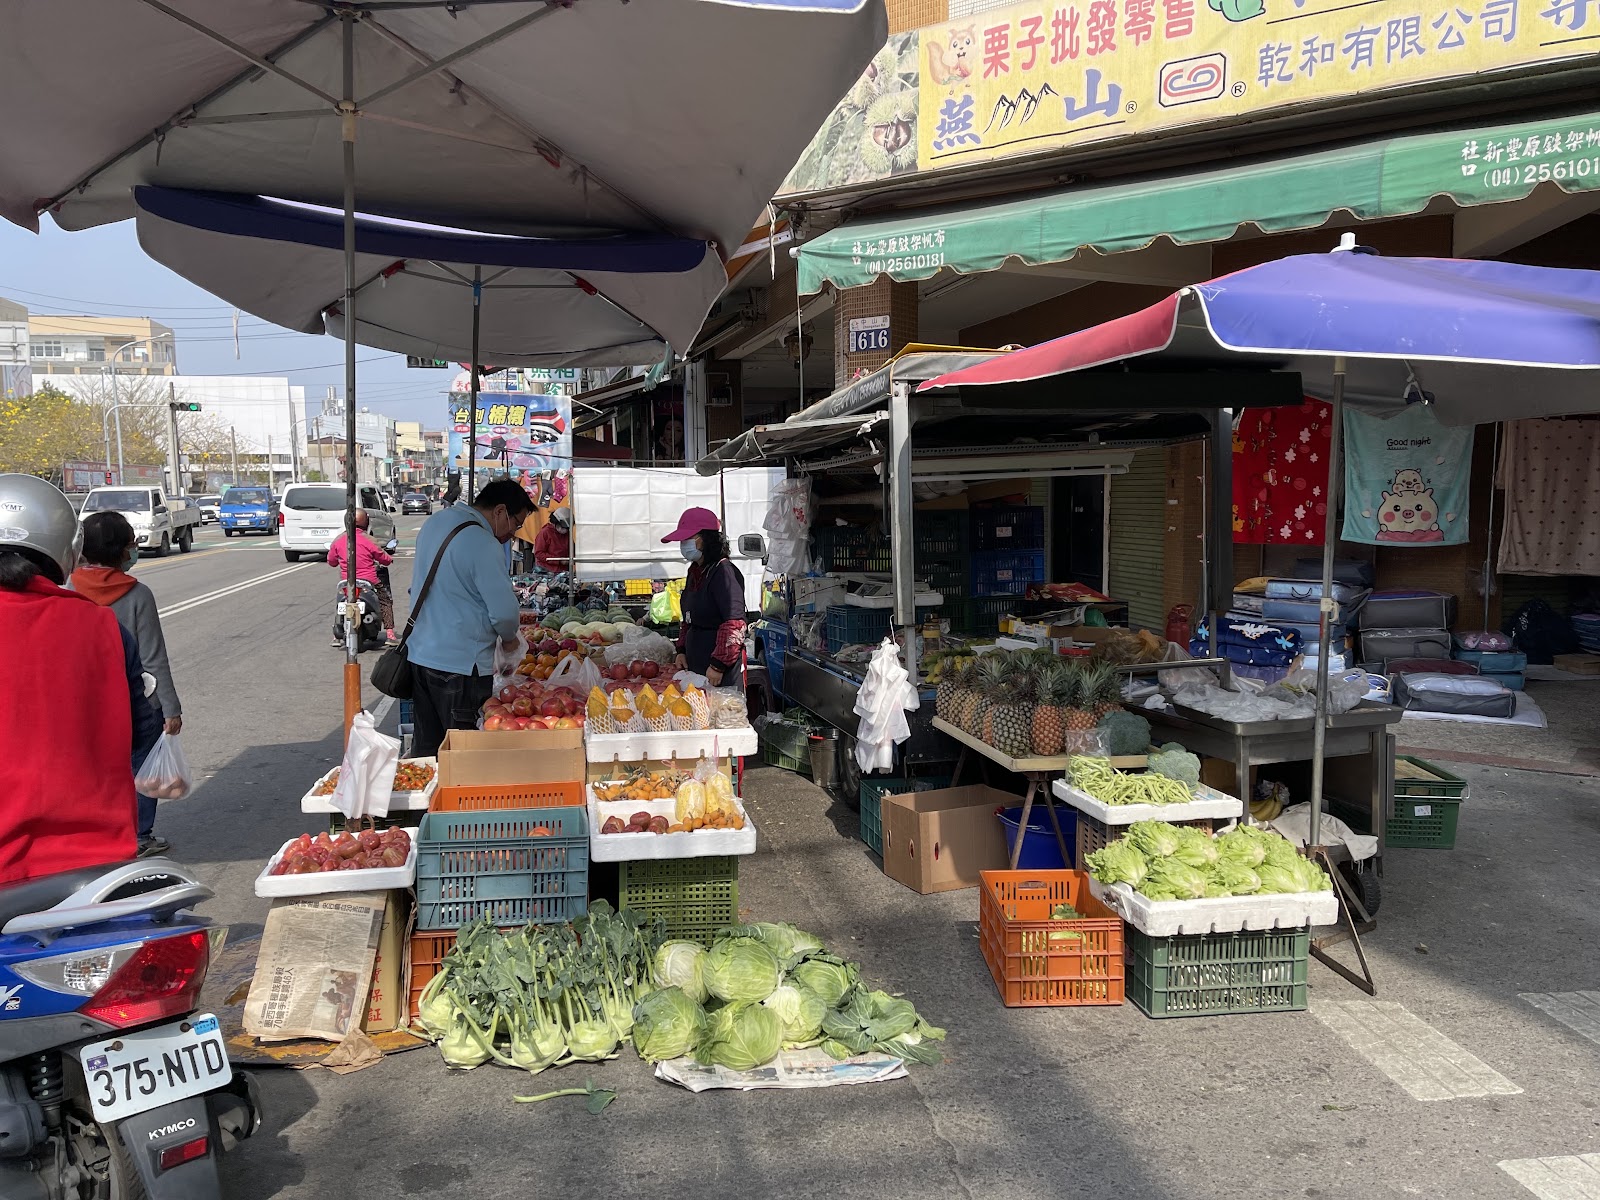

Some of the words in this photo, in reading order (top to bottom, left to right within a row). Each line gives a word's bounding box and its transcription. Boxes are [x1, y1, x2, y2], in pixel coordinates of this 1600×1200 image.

[1257, 0, 1519, 88] 乾和有限公司
[858, 330, 888, 350] 616
[1386, 438, 1408, 447] Good
[1410, 437, 1432, 447] night
[148, 1117, 196, 1141] KYMCO
